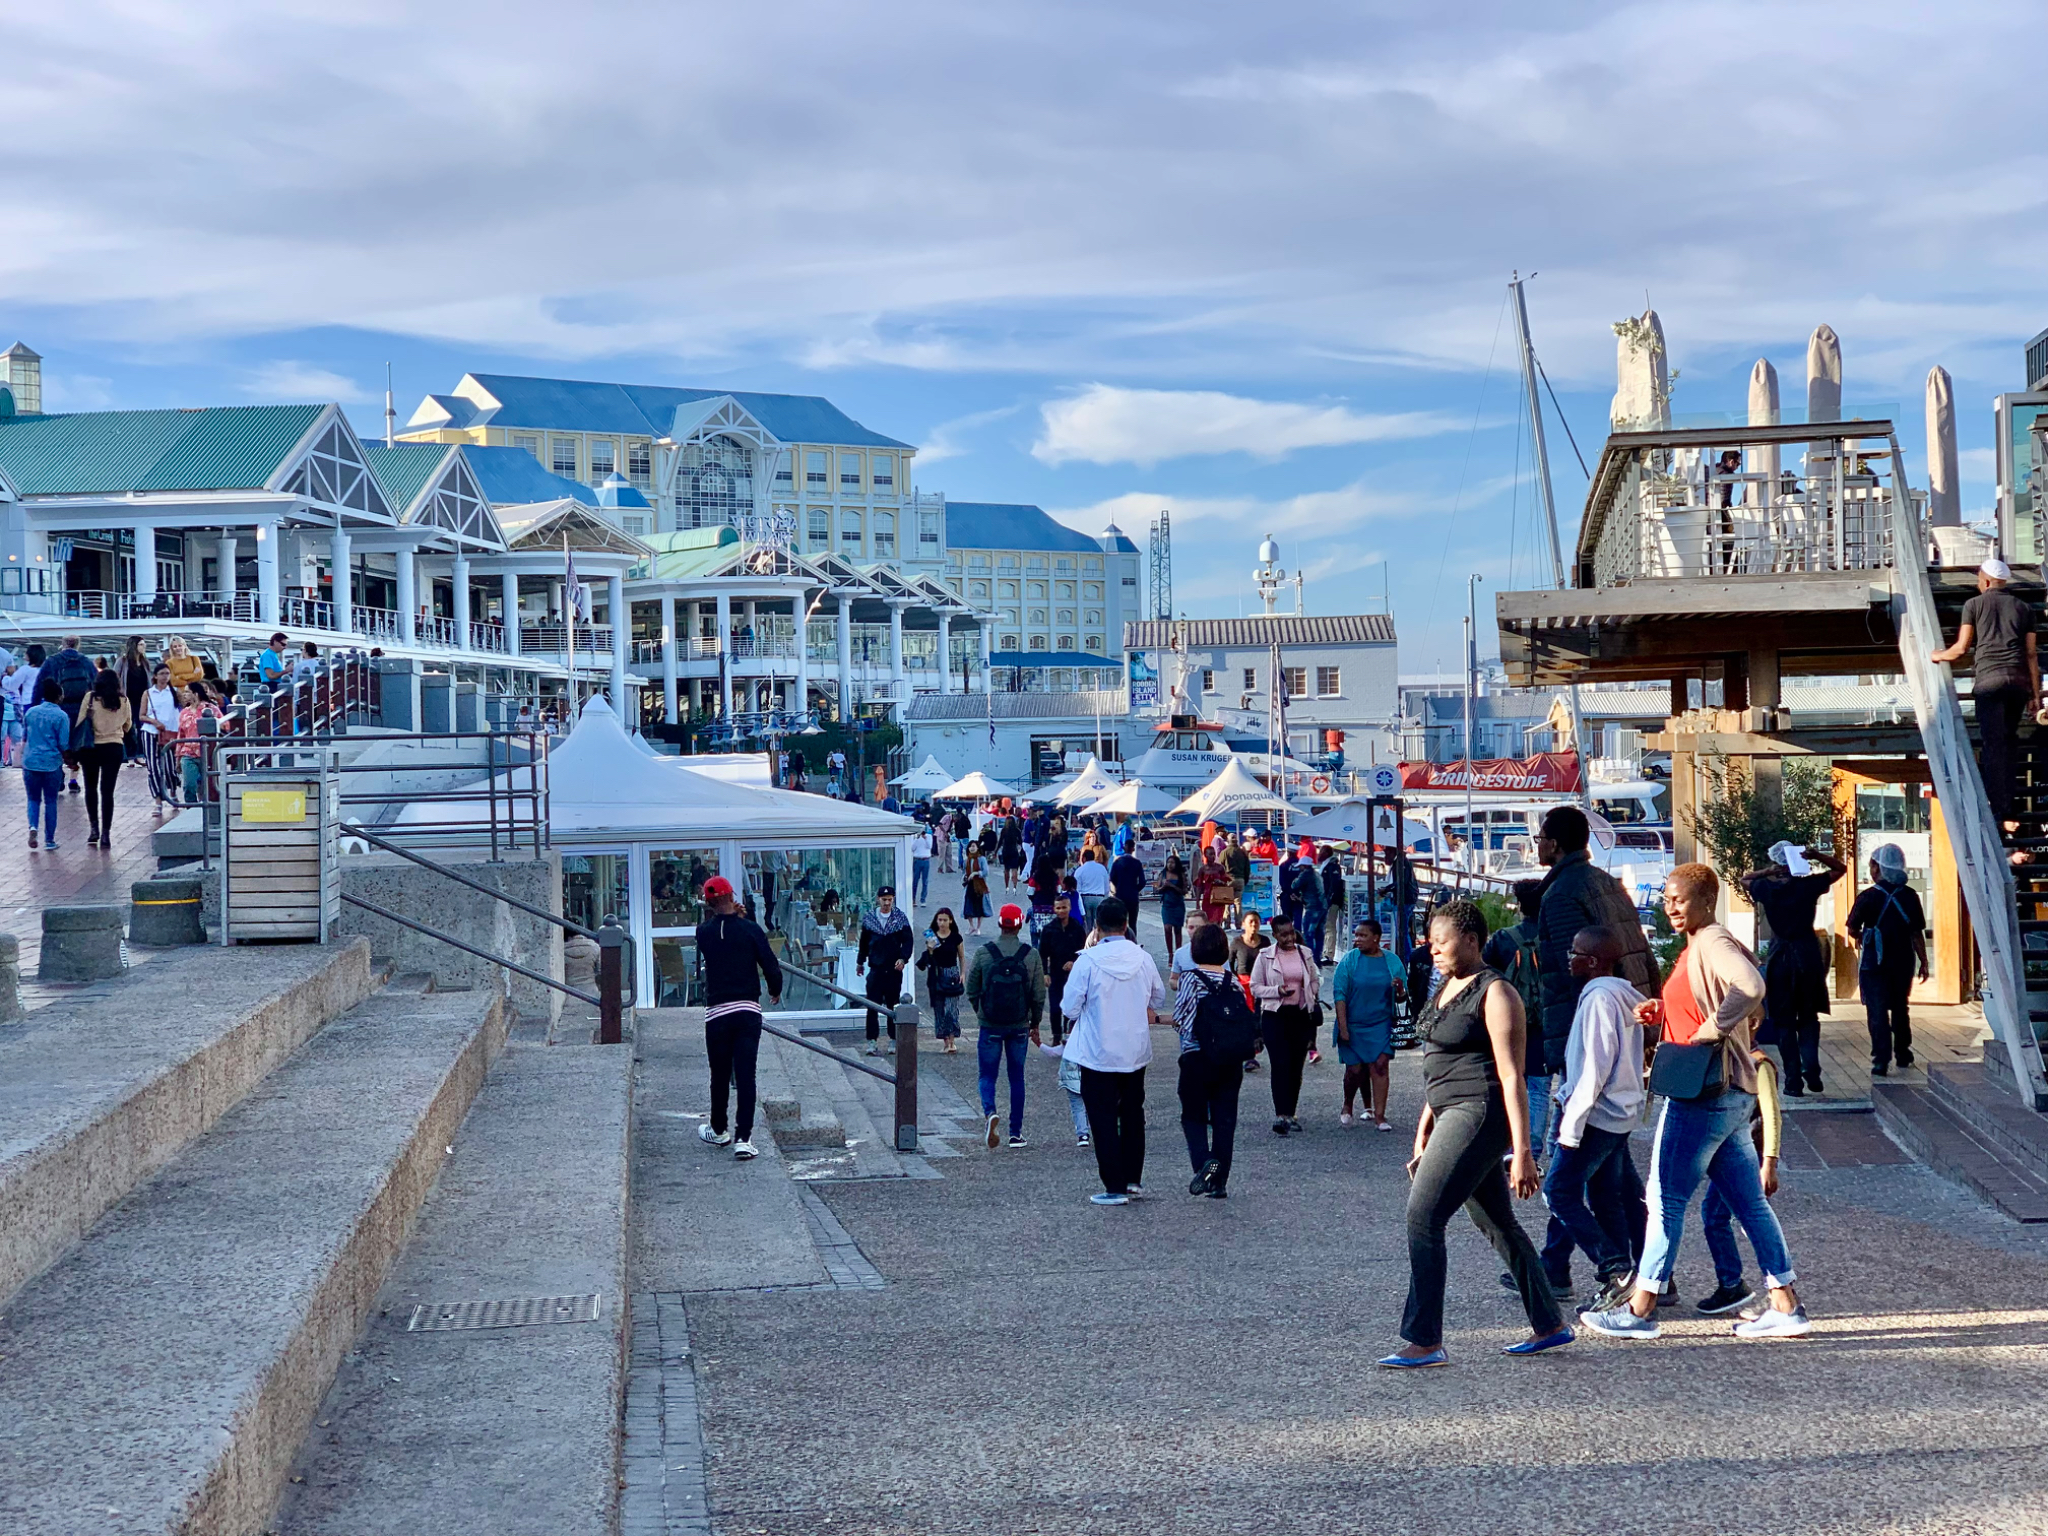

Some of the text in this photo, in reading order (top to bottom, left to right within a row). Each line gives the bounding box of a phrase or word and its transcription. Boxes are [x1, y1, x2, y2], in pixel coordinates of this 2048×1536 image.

[1171, 753, 1233, 763] SUSAN KRUGER
[1429, 772, 1547, 788] BRIDGESTONE
[1224, 792, 1275, 802] bonaqua
